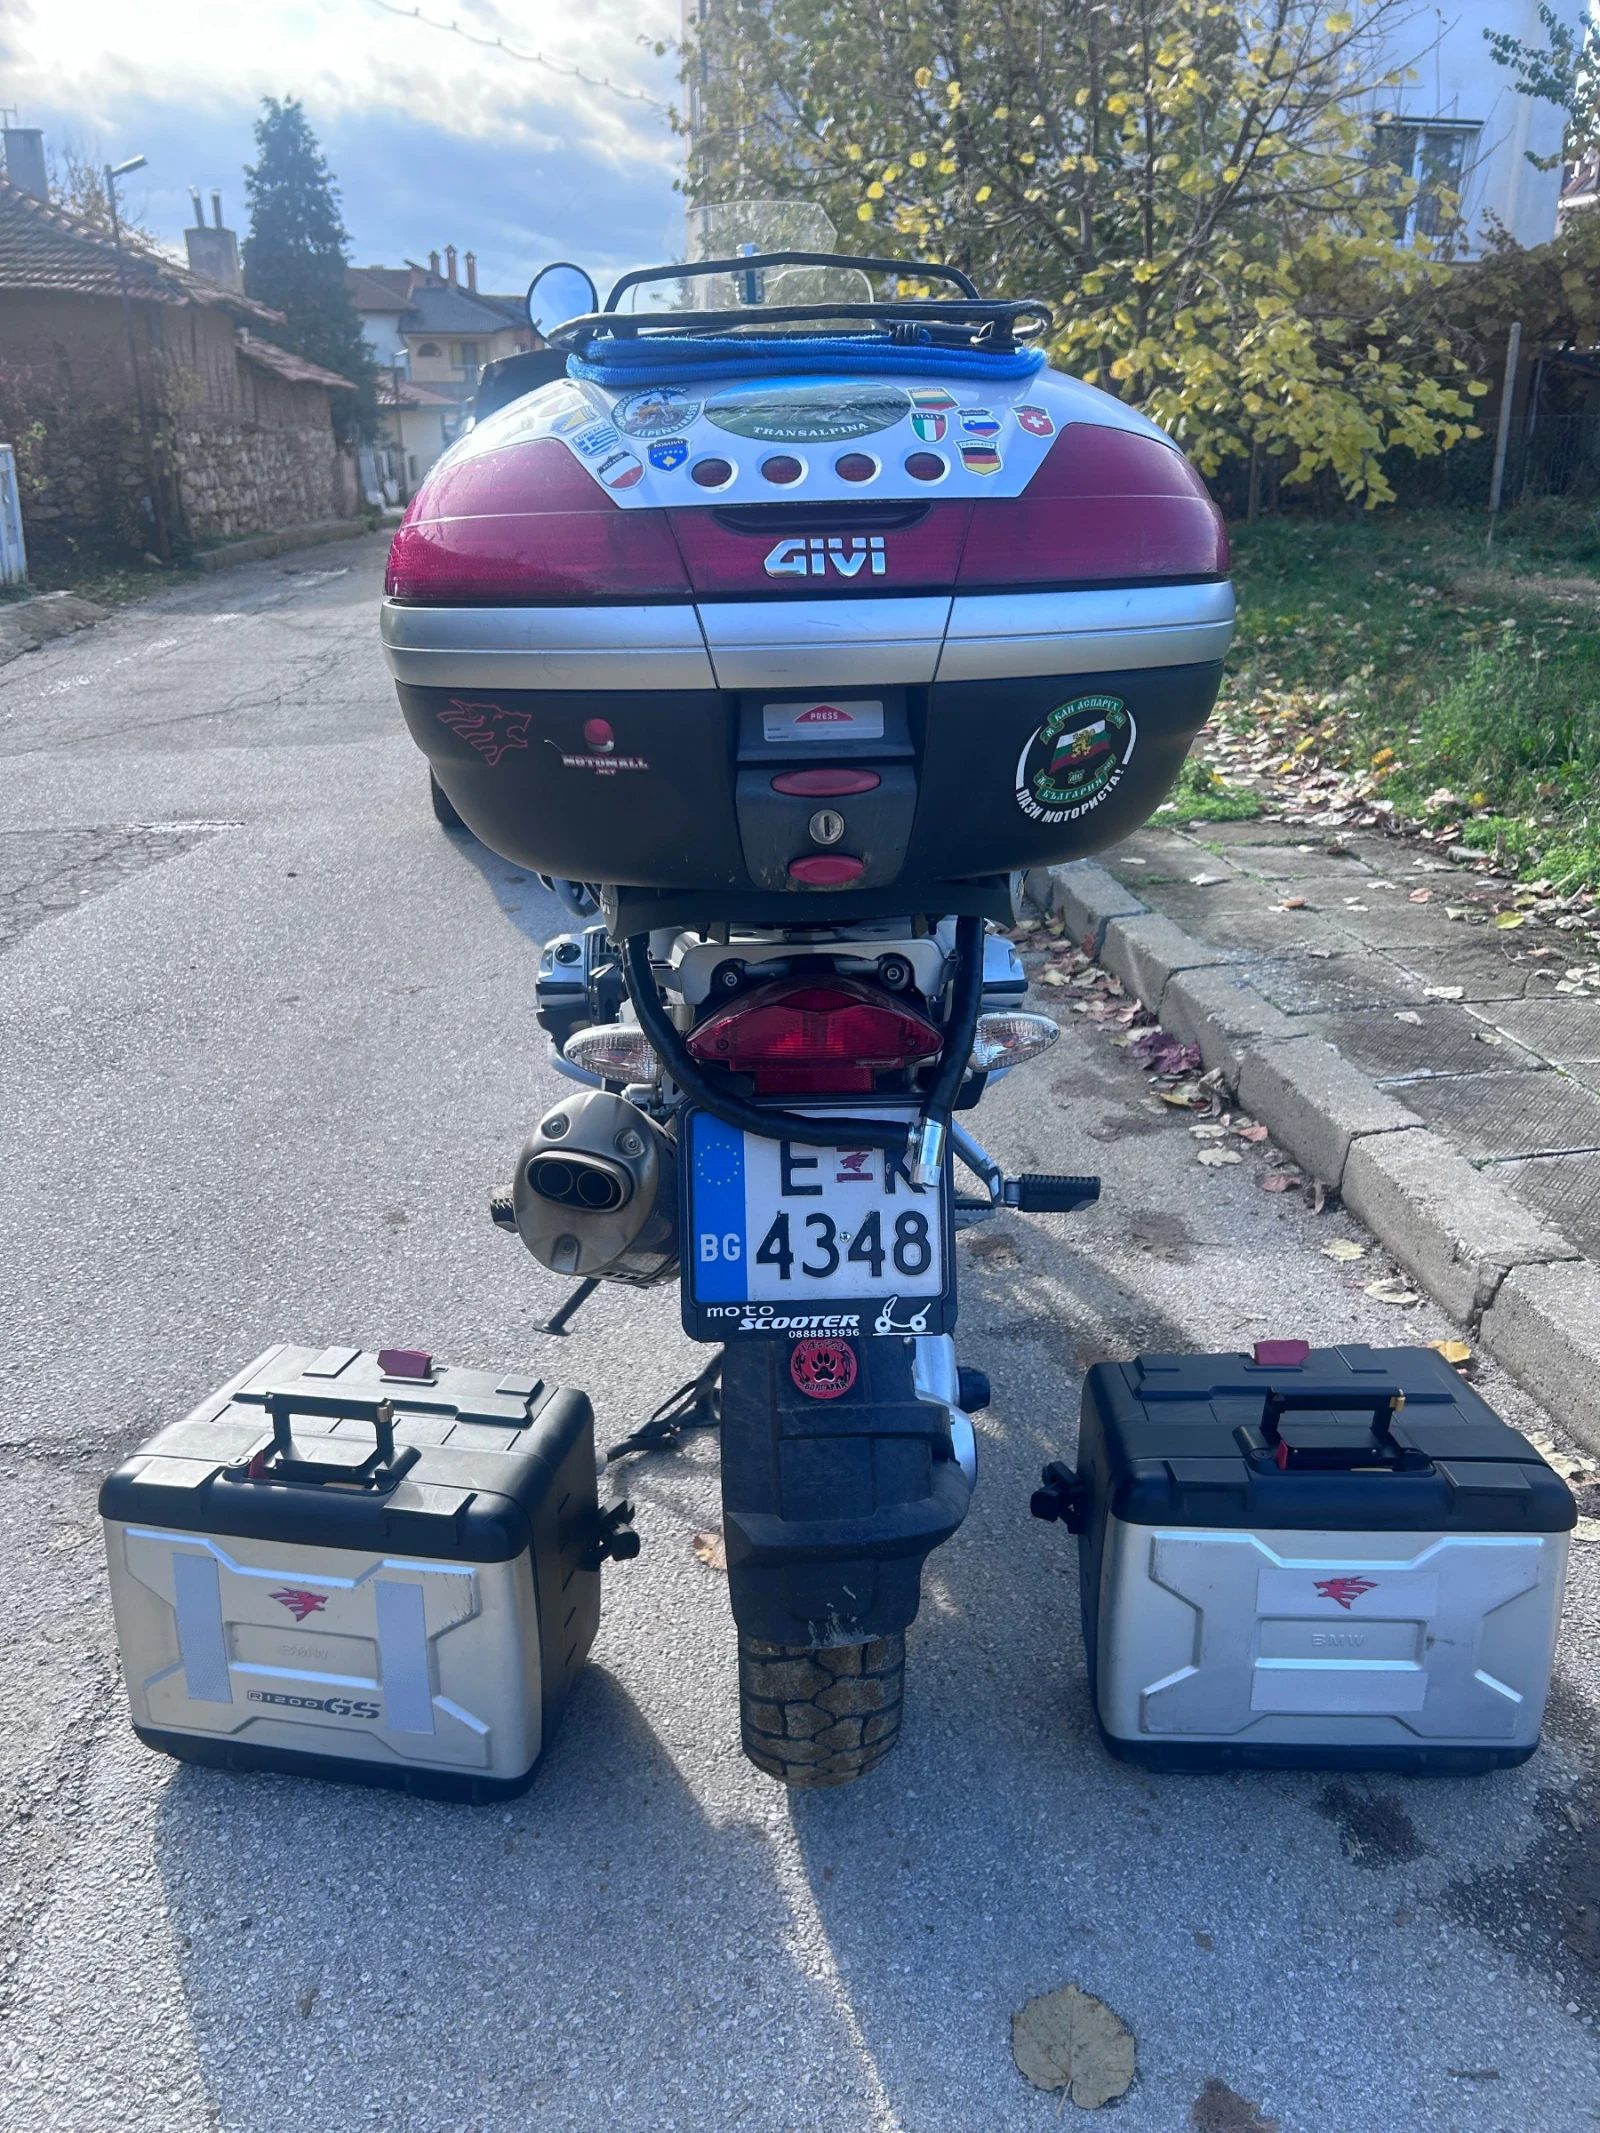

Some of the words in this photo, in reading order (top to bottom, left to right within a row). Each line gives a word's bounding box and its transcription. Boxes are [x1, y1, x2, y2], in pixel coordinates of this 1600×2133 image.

[632, 404, 699, 437] ALPENSTRASSE
[916, 413, 941, 421] ITALY
[753, 422, 869, 437] TRANSALPINA
[653, 440, 684, 449] KOSOVO
[602, 453, 624, 469] POLAND
[764, 537, 886, 578] GIVI
[810, 712, 838, 720] PRESS
[1054, 705, 1074, 722] КАН
[1077, 698, 1119, 711] АСПАРУХ
[562, 755, 648, 769] MOTOMALL
[1016, 788, 1044, 819] ПАЗИ
[1041, 768, 1124, 823] МОТОРИСТА!
[1042, 777, 1103, 801] БЪЛГАРИЯ
[781, 1140, 822, 1196] E
[700, 1232, 741, 1263] BG
[756, 1210, 932, 1280] 4348
[707, 1305, 774, 1318] moto
[738, 1314, 860, 1331] SCOOTER
[788, 1328, 860, 1339] 0888835936
[1310, 1633, 1366, 1647] BMW
[280, 1644, 329, 1661] BMW
